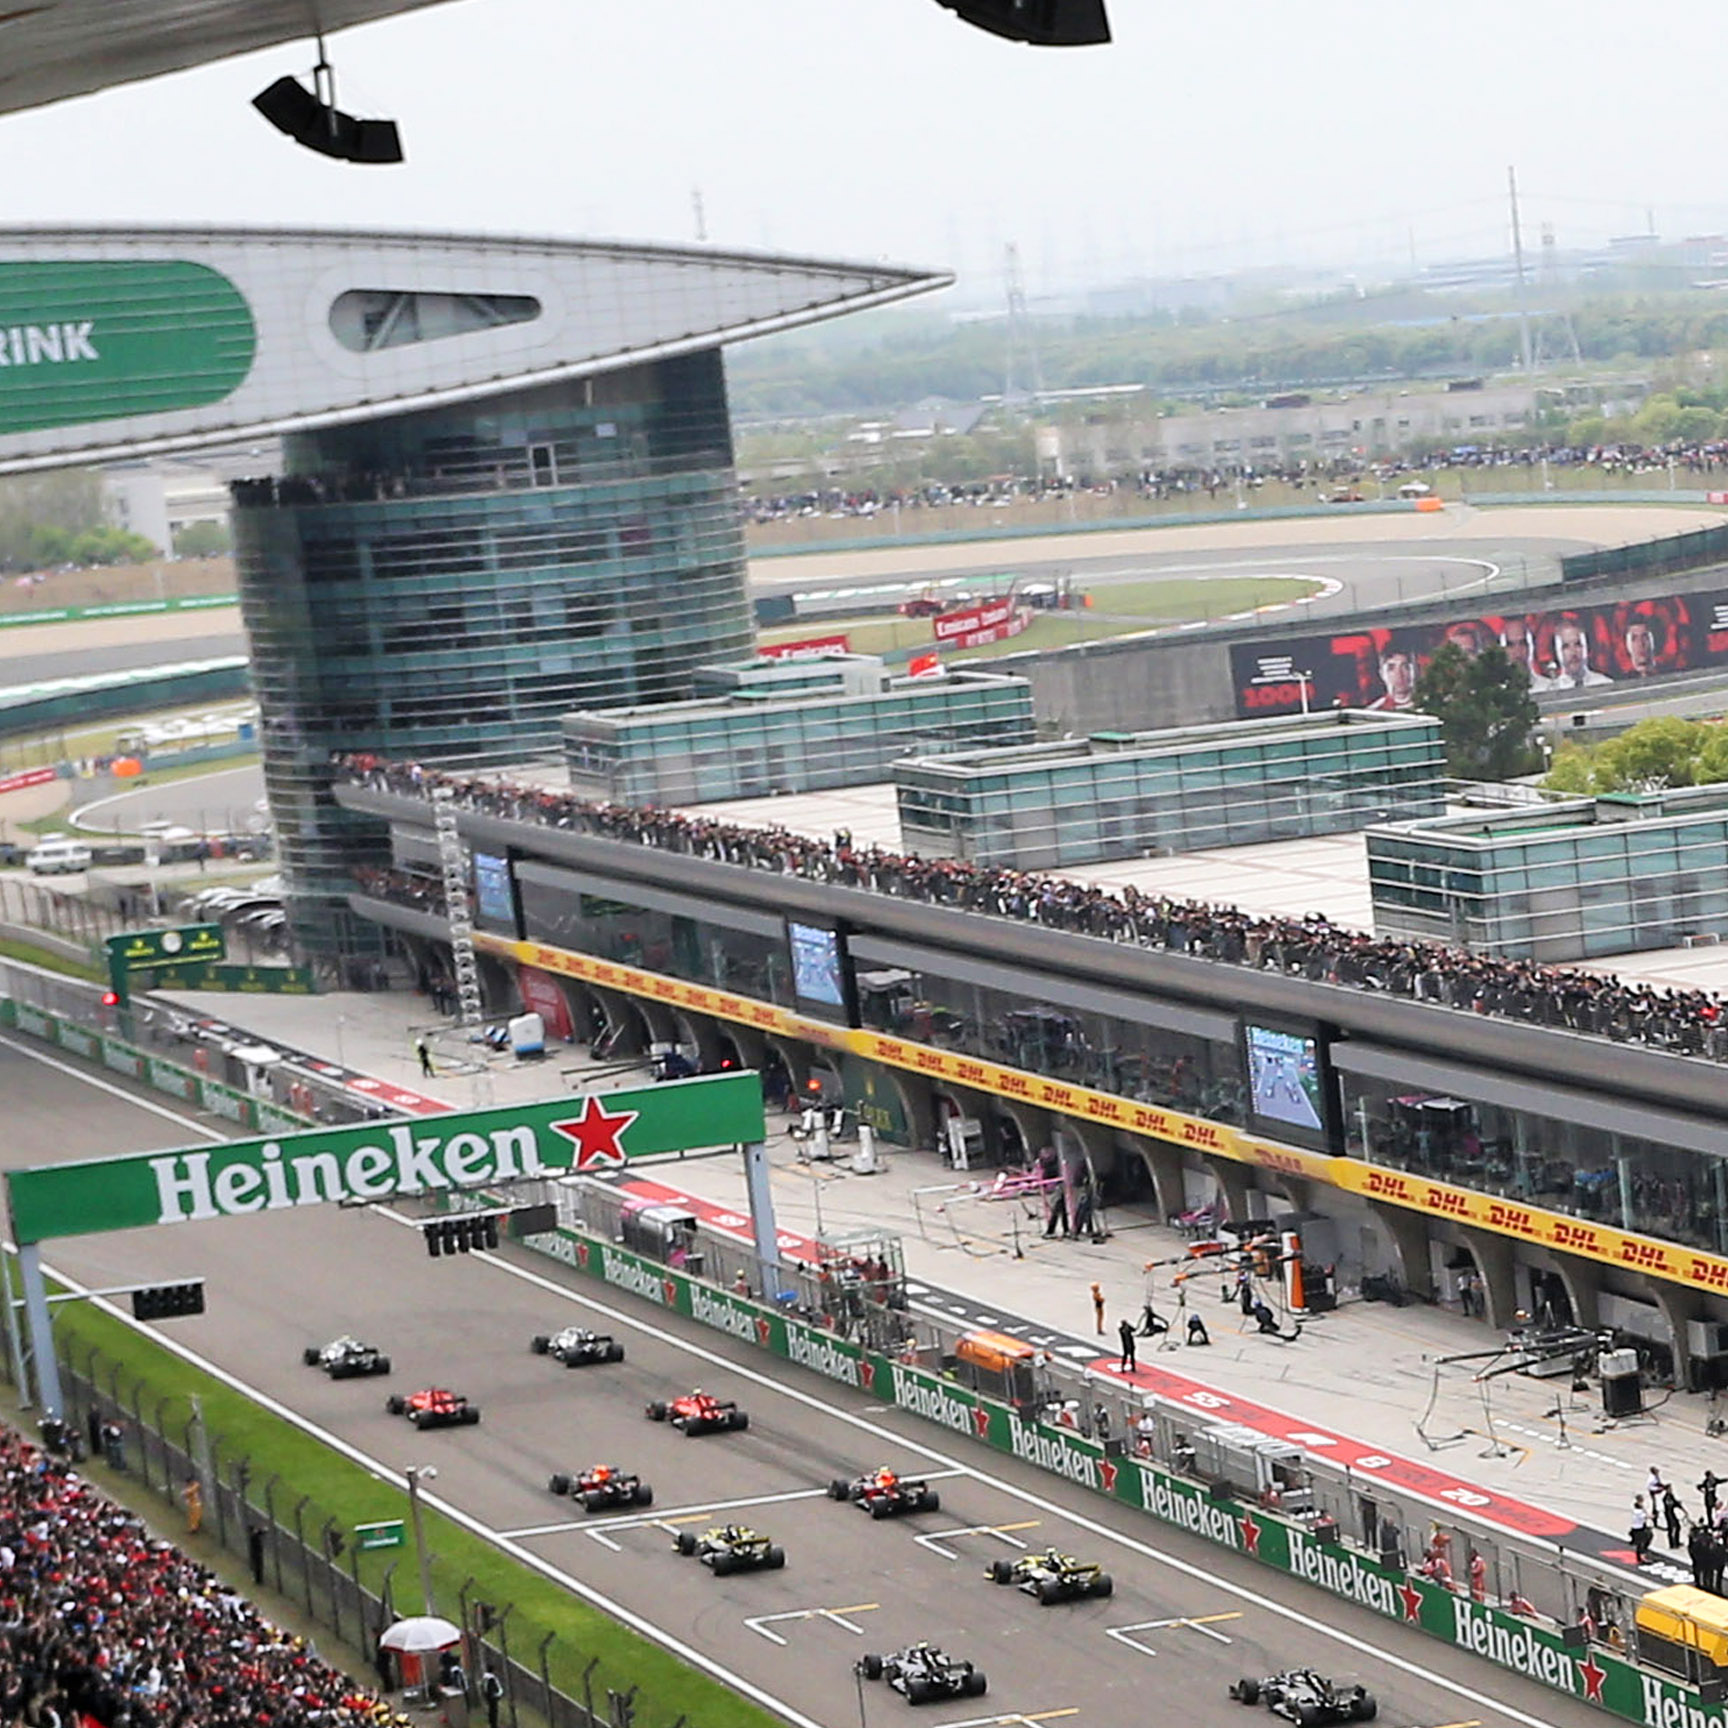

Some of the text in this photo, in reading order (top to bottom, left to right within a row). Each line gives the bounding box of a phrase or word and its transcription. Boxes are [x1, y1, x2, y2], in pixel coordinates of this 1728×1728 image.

[148, 1124, 546, 1224] Heineken
[1368, 1172, 1409, 1199] DHL
[1428, 1188, 1470, 1216] DHL
[1489, 1205, 1534, 1234] DHL
[1553, 1222, 1599, 1252] DHL
[1621, 1240, 1669, 1271] DHL
[786, 1322, 857, 1387] Heineken
[892, 1364, 972, 1434] Heineken
[1009, 1413, 1098, 1489] Heineken
[1139, 1467, 1239, 1548] Heineken
[1286, 1530, 1397, 1616] Heineken
[1454, 1596, 1575, 1692] Heineken
